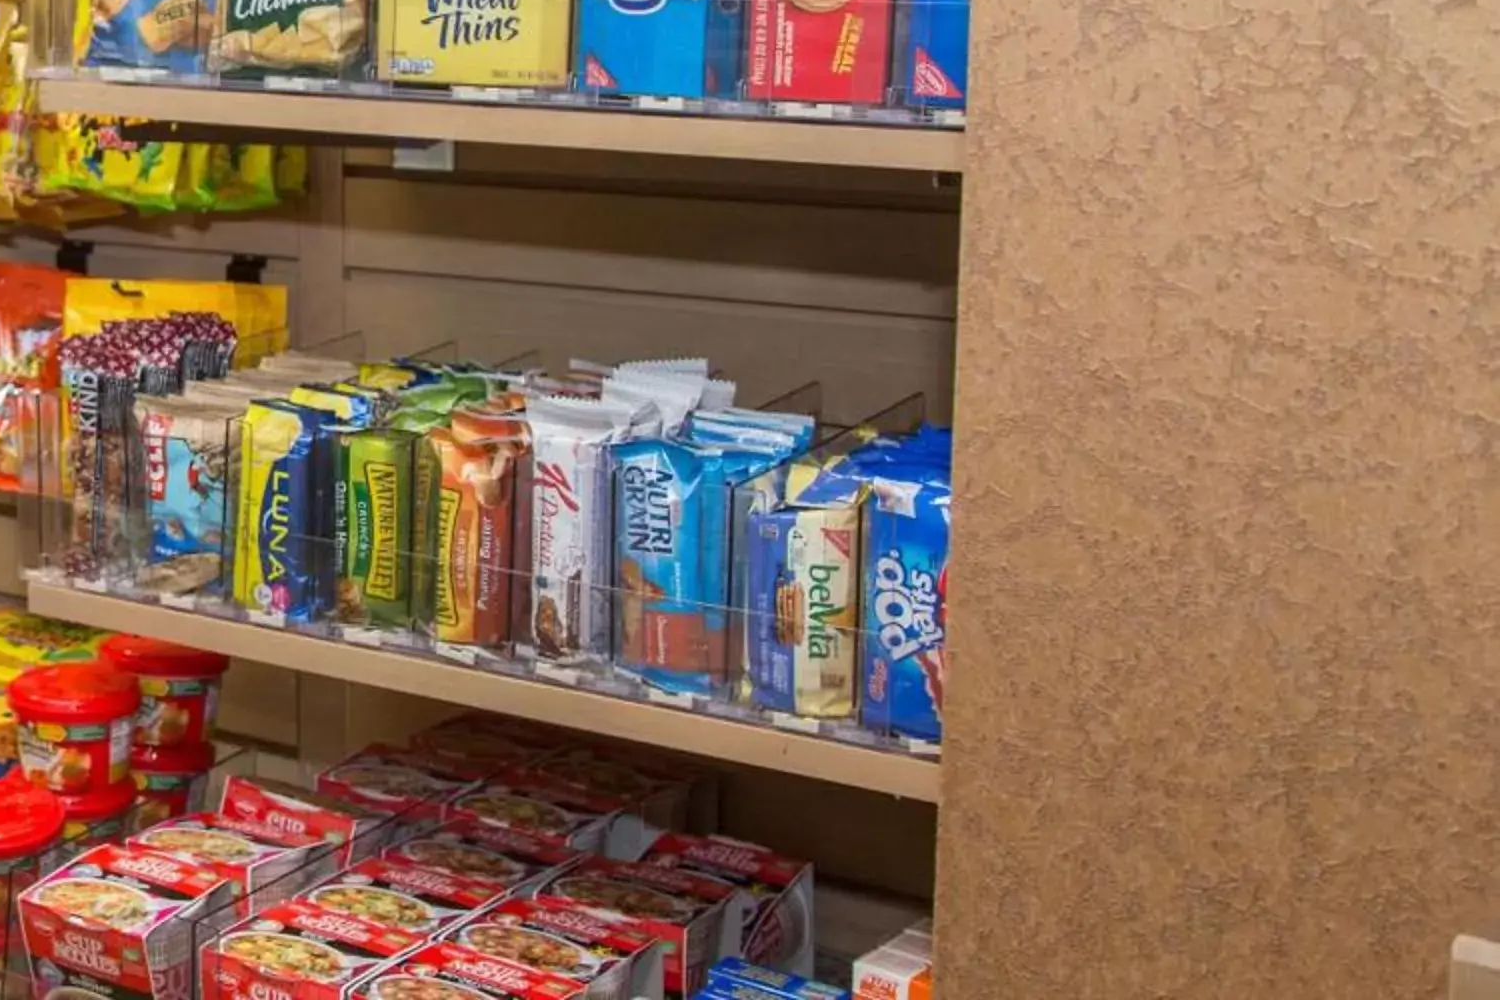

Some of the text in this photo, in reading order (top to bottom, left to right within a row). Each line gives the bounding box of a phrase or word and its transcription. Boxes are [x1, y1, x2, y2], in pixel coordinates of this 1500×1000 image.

[421, 9, 522, 50] Thins
[79, 370, 98, 433] KIND
[268, 469, 291, 582] LUNA
[623, 465, 651, 552] GRAIN
[646, 469, 674, 554] NUTRI
[478, 516, 494, 560] Butter
[265, 810, 306, 834] CUP
[64, 930, 105, 953] CUP
